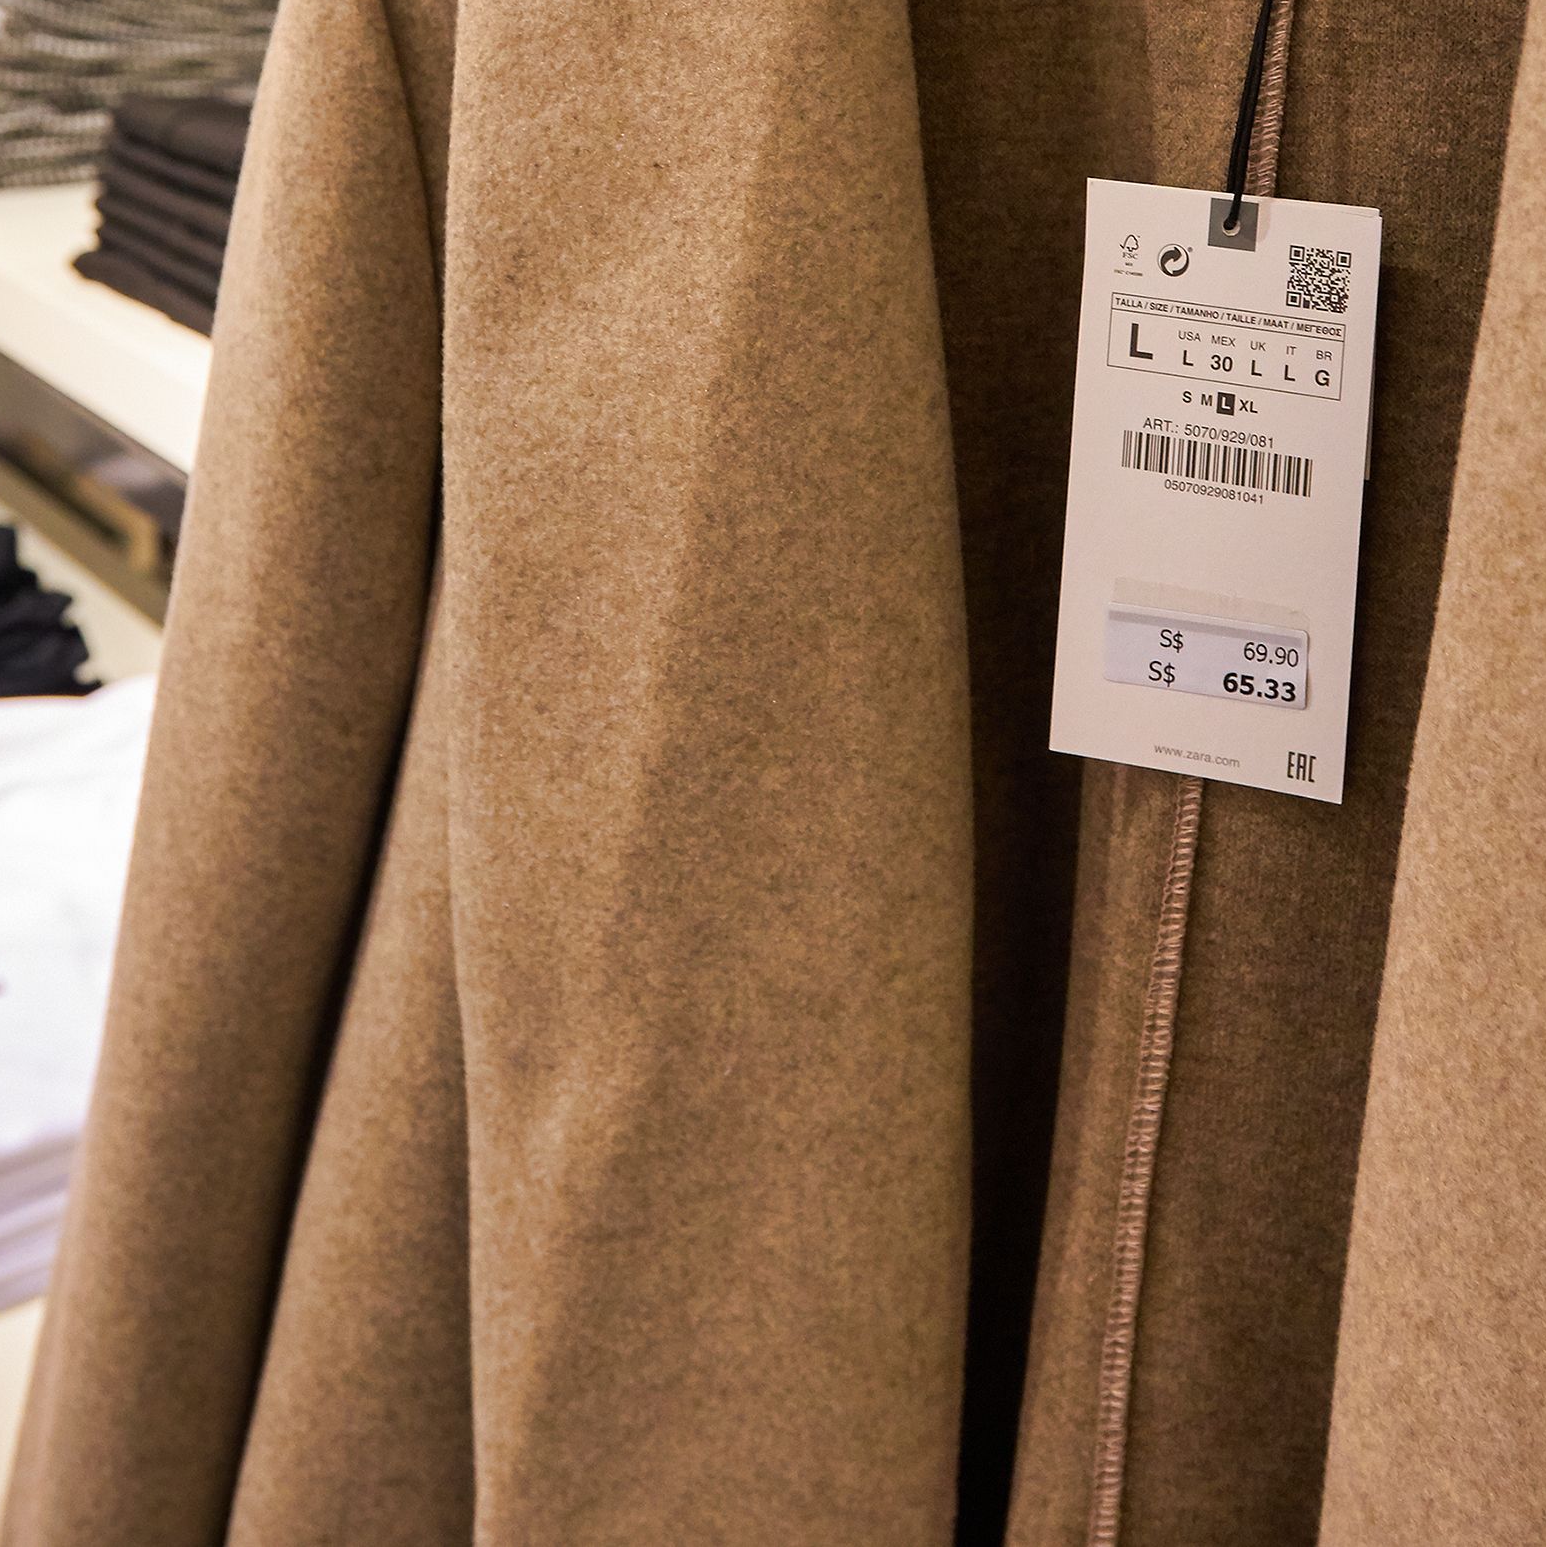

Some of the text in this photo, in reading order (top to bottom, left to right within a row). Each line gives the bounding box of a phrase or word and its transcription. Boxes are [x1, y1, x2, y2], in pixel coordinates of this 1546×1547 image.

[1115, 297, 1143, 309] TALLA
[1149, 302, 1168, 312] SIZE
[1175, 305, 1220, 320] TAMANHO
[1226, 312, 1256, 325] TAILLE
[1263, 318, 1289, 330] MAAT
[1129, 322, 1153, 360] L
[1178, 330, 1332, 361] USA MEX UK IT BR
[1183, 350, 1331, 387] L 30 L L G
[1182, 390, 1193, 403] S
[1200, 393, 1213, 406] M
[1239, 399, 1258, 414] XL
[1142, 417, 1274, 448] ART.: 5070/929/081
[1164, 478, 1264, 505] 05070929081041
[1159, 629, 1299, 668] S$ 69.90
[1148, 660, 1297, 702] S$ 65.33
[1154, 744, 1240, 768] www.zara.com
